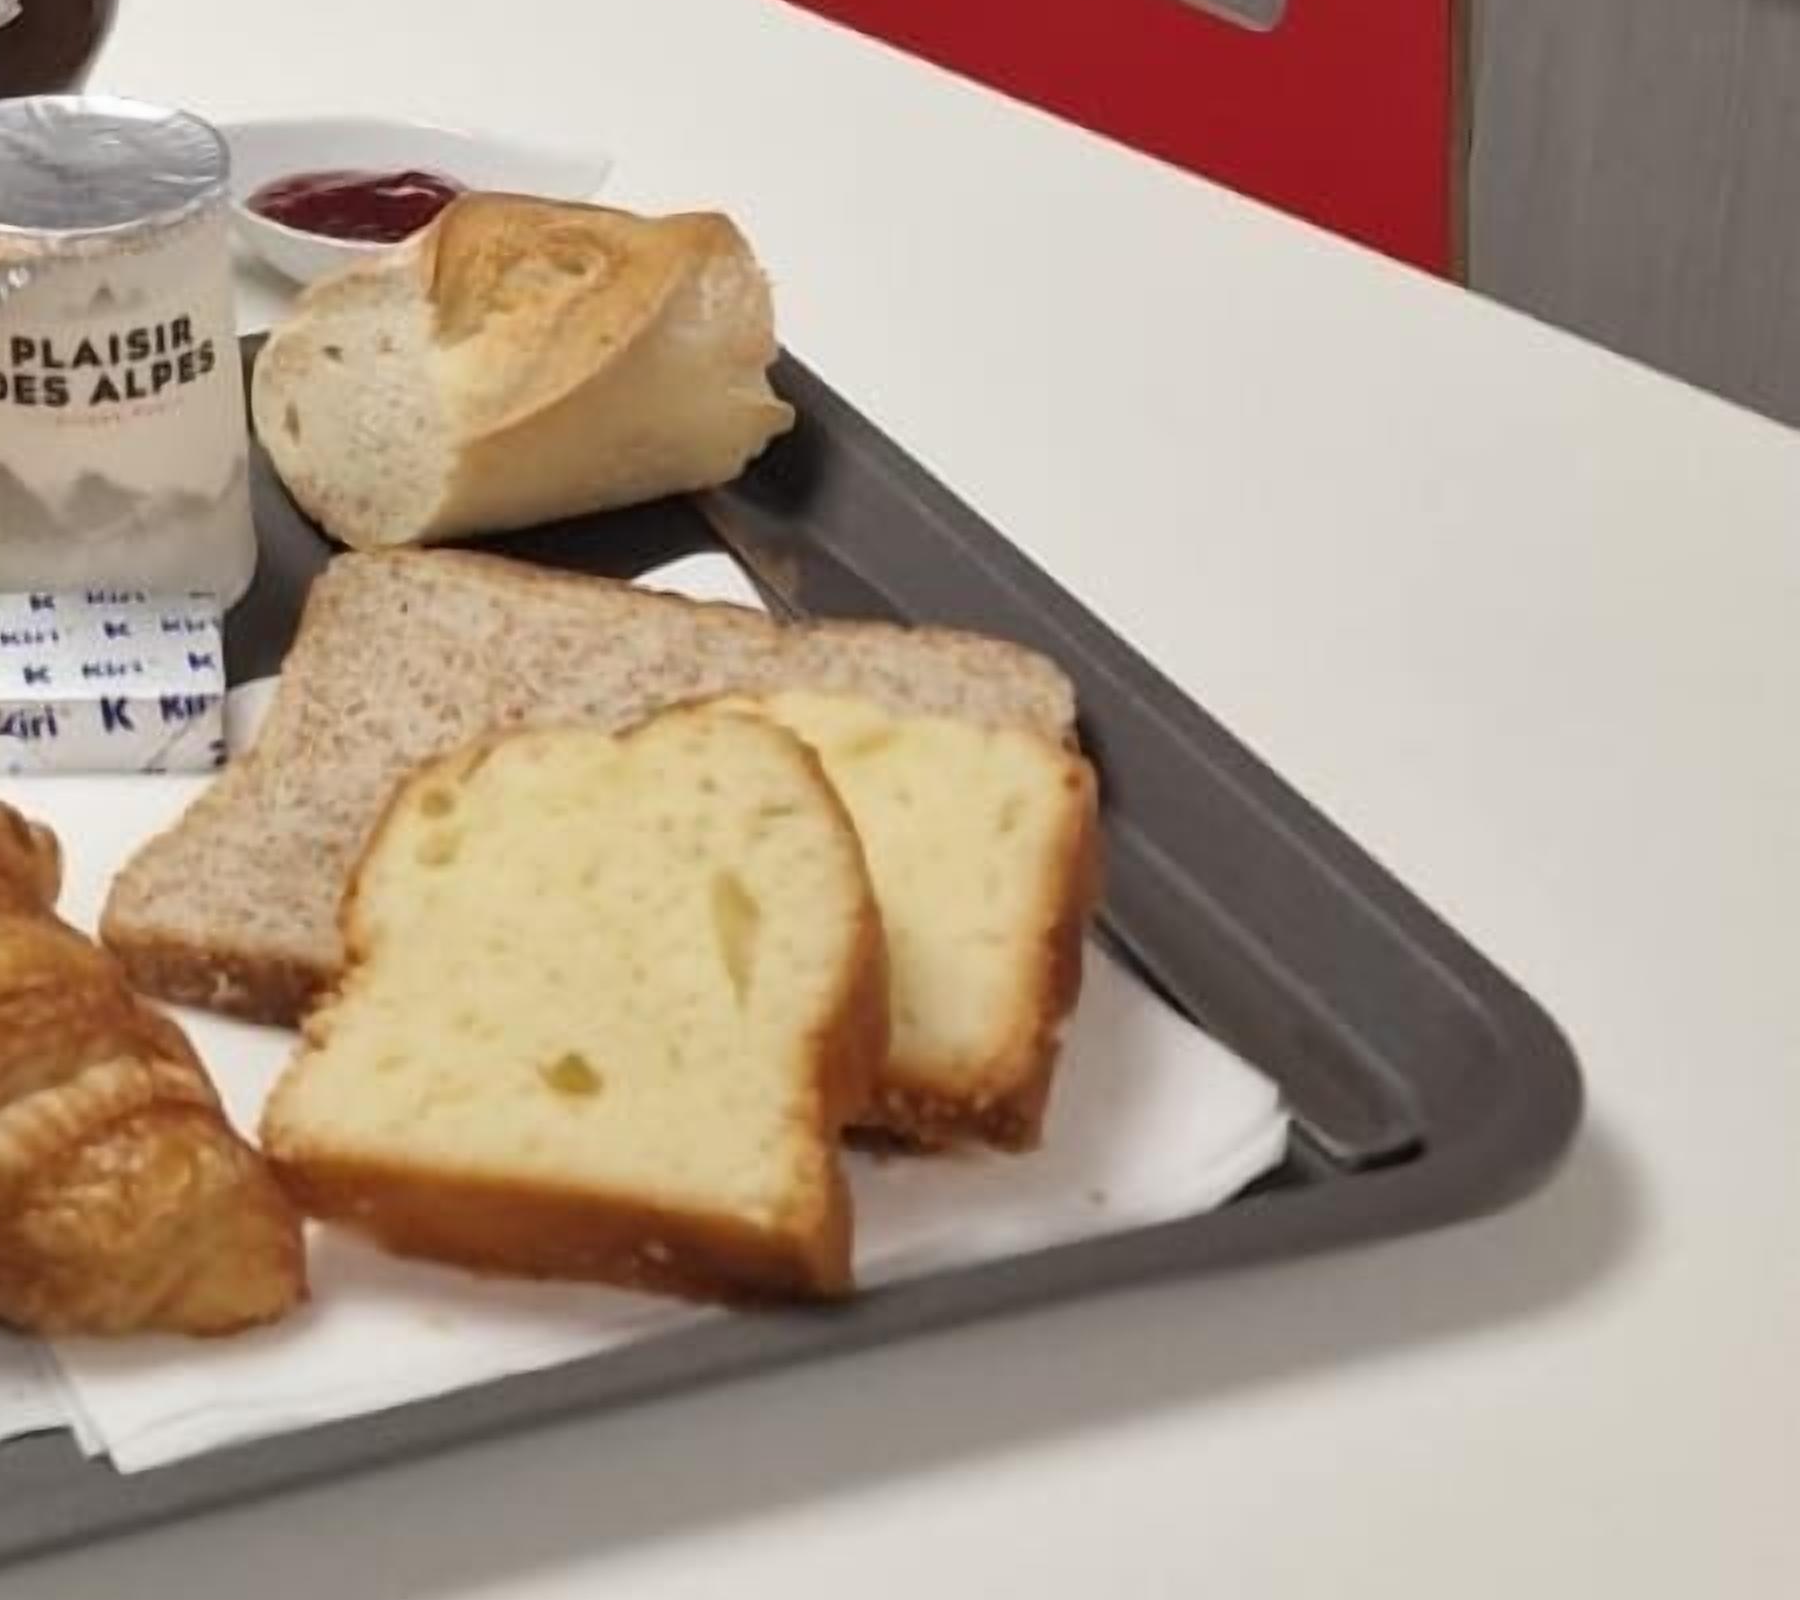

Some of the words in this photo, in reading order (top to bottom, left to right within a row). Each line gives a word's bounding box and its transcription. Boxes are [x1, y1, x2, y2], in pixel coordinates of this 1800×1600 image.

[10, 313, 194, 371] PLAISIR
[88, 339, 217, 407] ALPES
[100, 696, 135, 734] K
